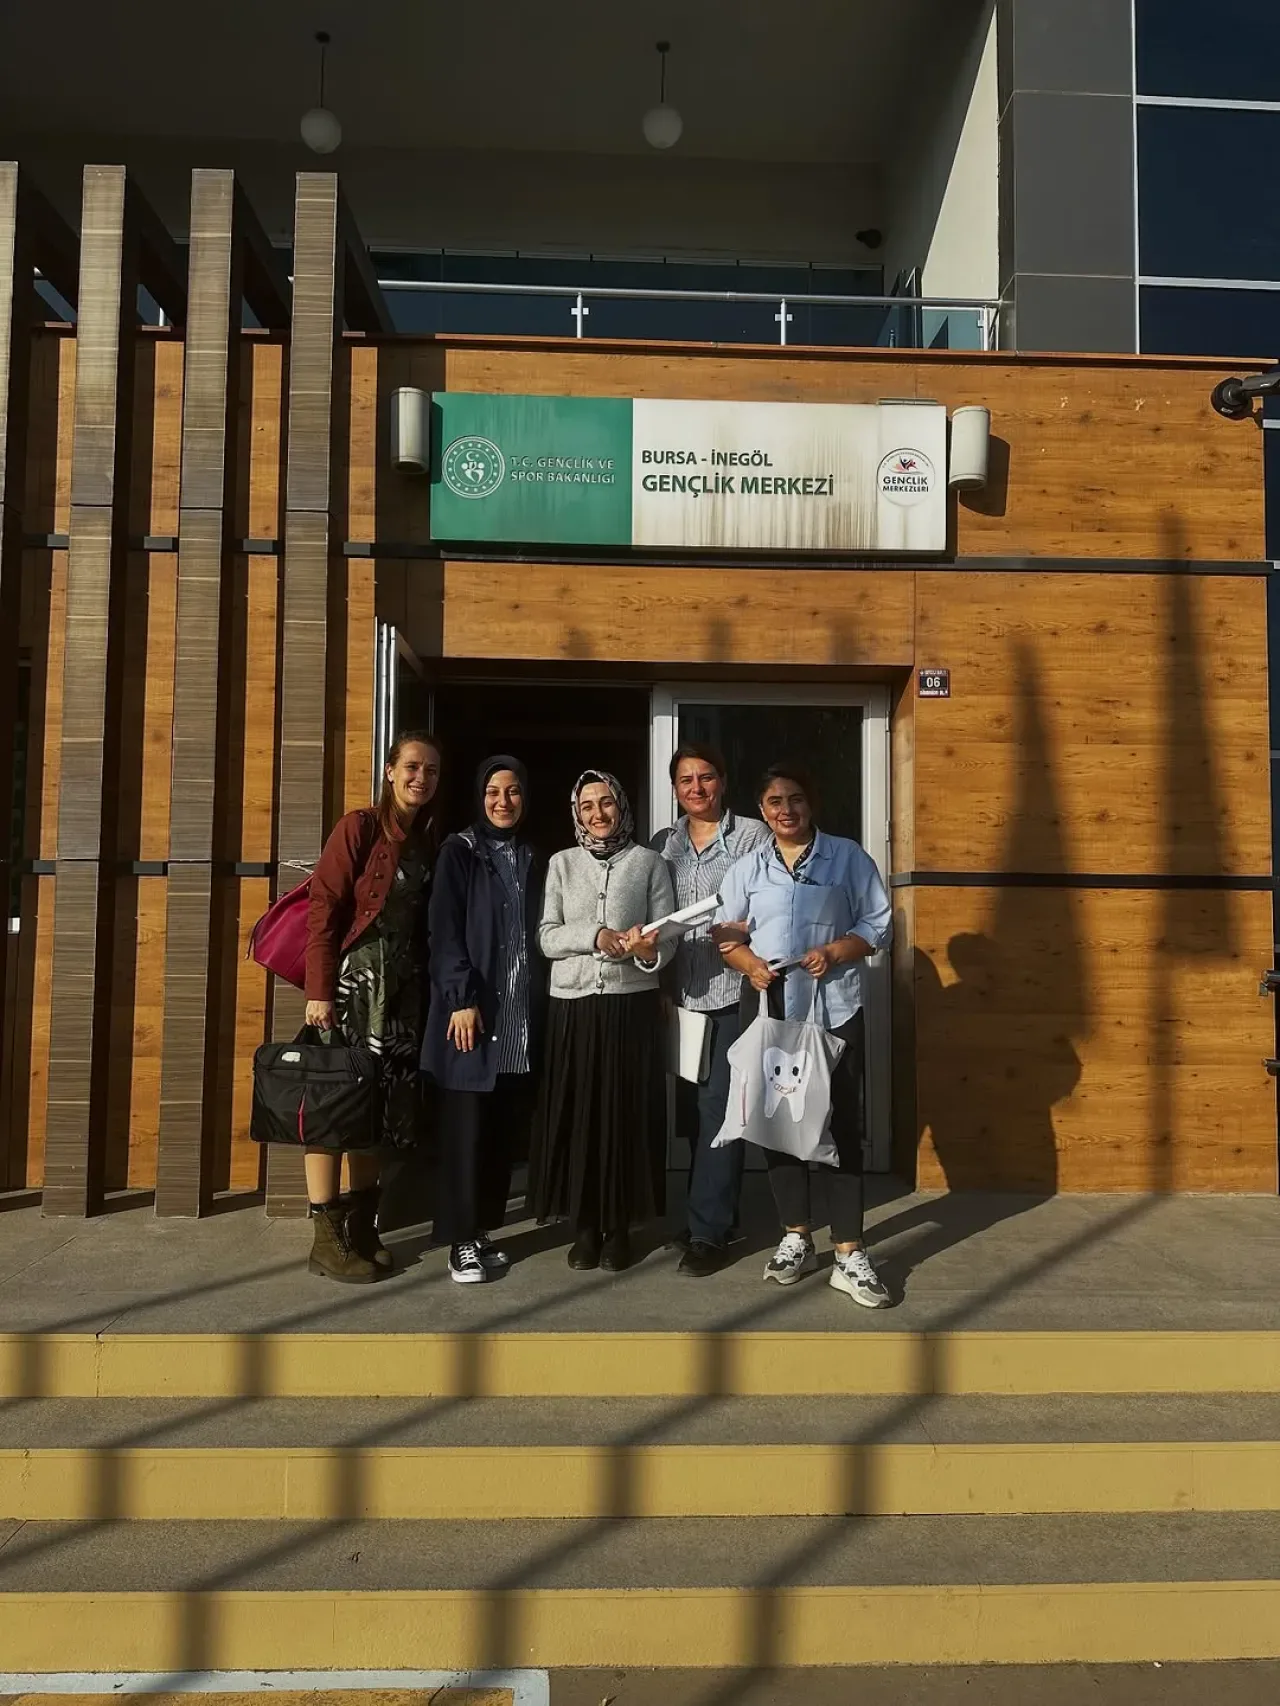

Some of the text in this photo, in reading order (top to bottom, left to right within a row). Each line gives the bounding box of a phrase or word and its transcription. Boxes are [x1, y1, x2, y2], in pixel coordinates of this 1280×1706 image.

[510, 456, 615, 470] T.C. GENÇLİK VE
[641, 450, 698, 465] BURSA
[711, 449, 774, 467] İNEGÖL
[510, 470, 544, 482] SPOR
[641, 473, 834, 498] GENÇLİK MERKEZİ
[926, 676, 941, 688] 06
